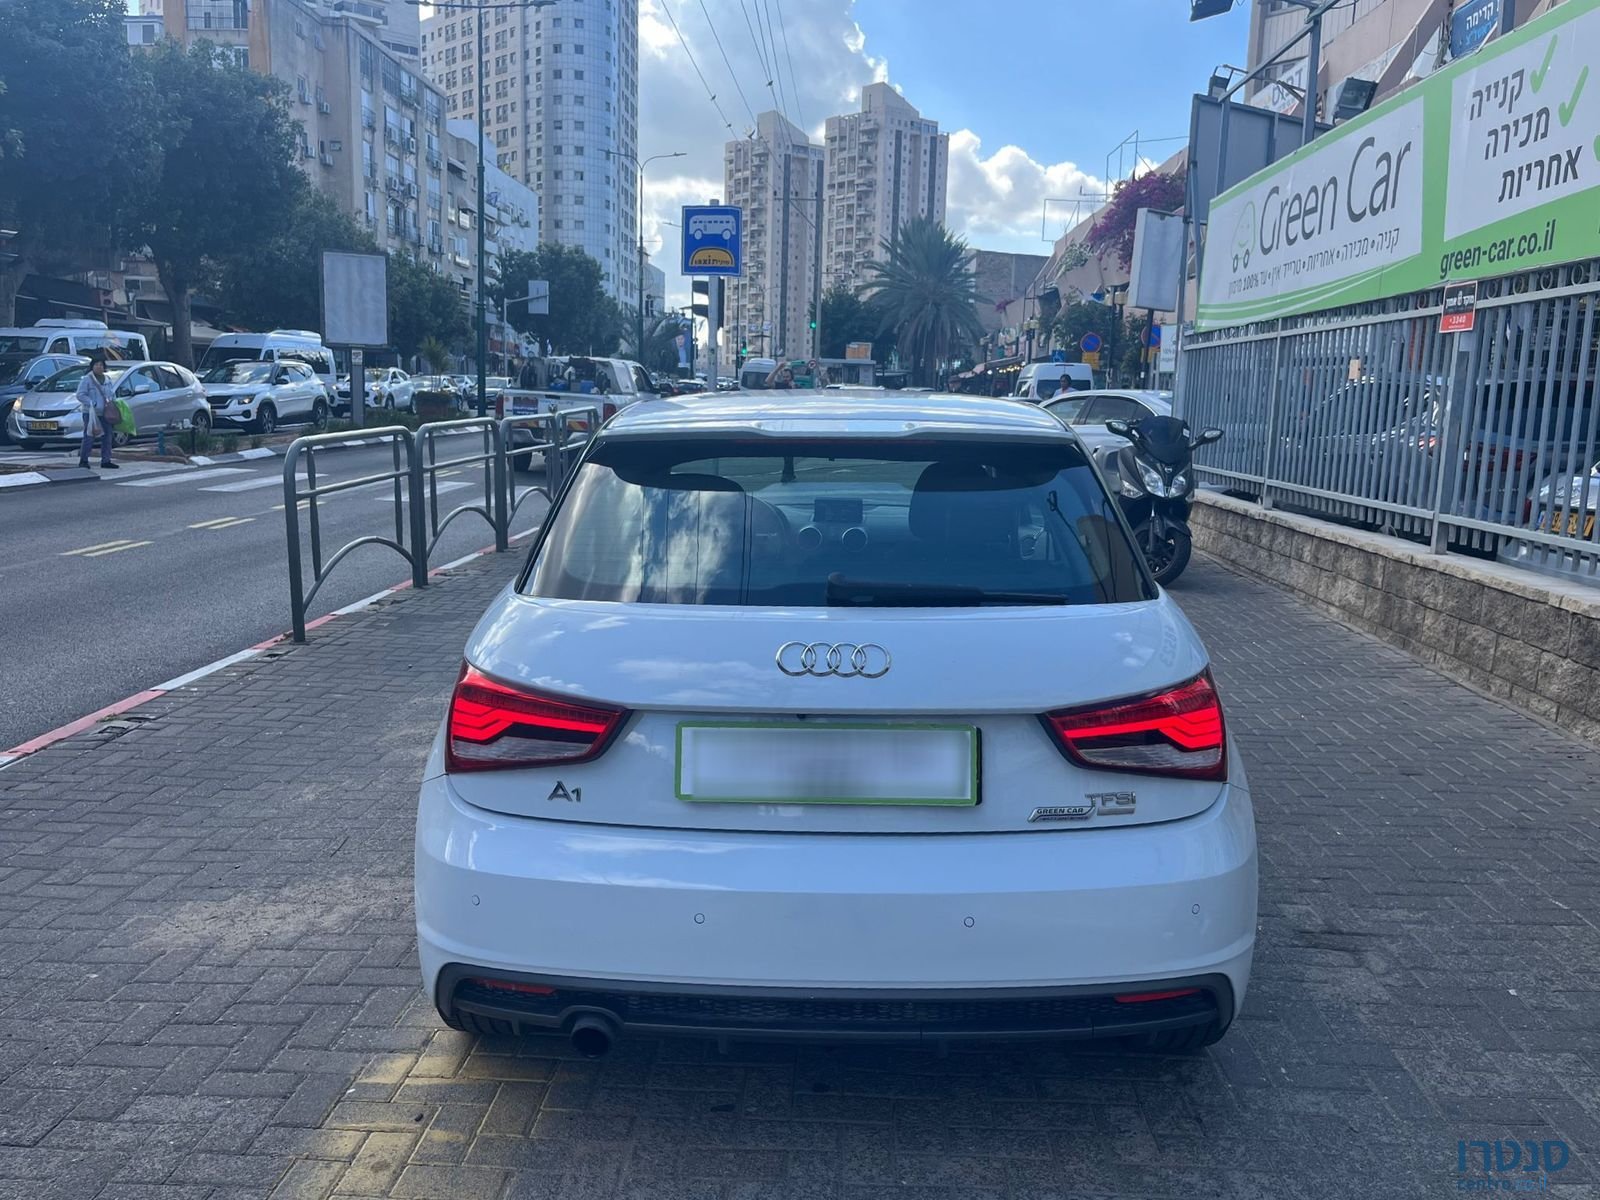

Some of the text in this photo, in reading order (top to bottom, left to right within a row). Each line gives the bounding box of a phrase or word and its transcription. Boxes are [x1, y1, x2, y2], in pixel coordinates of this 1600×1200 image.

[1466, 2, 1494, 30] קדימה
[1470, 68, 1524, 121] קנייה
[1485, 106, 1550, 160] מכירה
[1498, 145, 1583, 203] אחריות
[1260, 136, 1412, 256] Green Car
[1341, 237, 1369, 261] מכירה
[1375, 228, 1400, 254] קניה
[1440, 218, 1557, 280] green-car.co.il
[1306, 248, 1336, 272] אחריות
[1243, 272, 1259, 291] 100%
[547, 780, 582, 802] A1
[1085, 791, 1136, 807] TFSI
